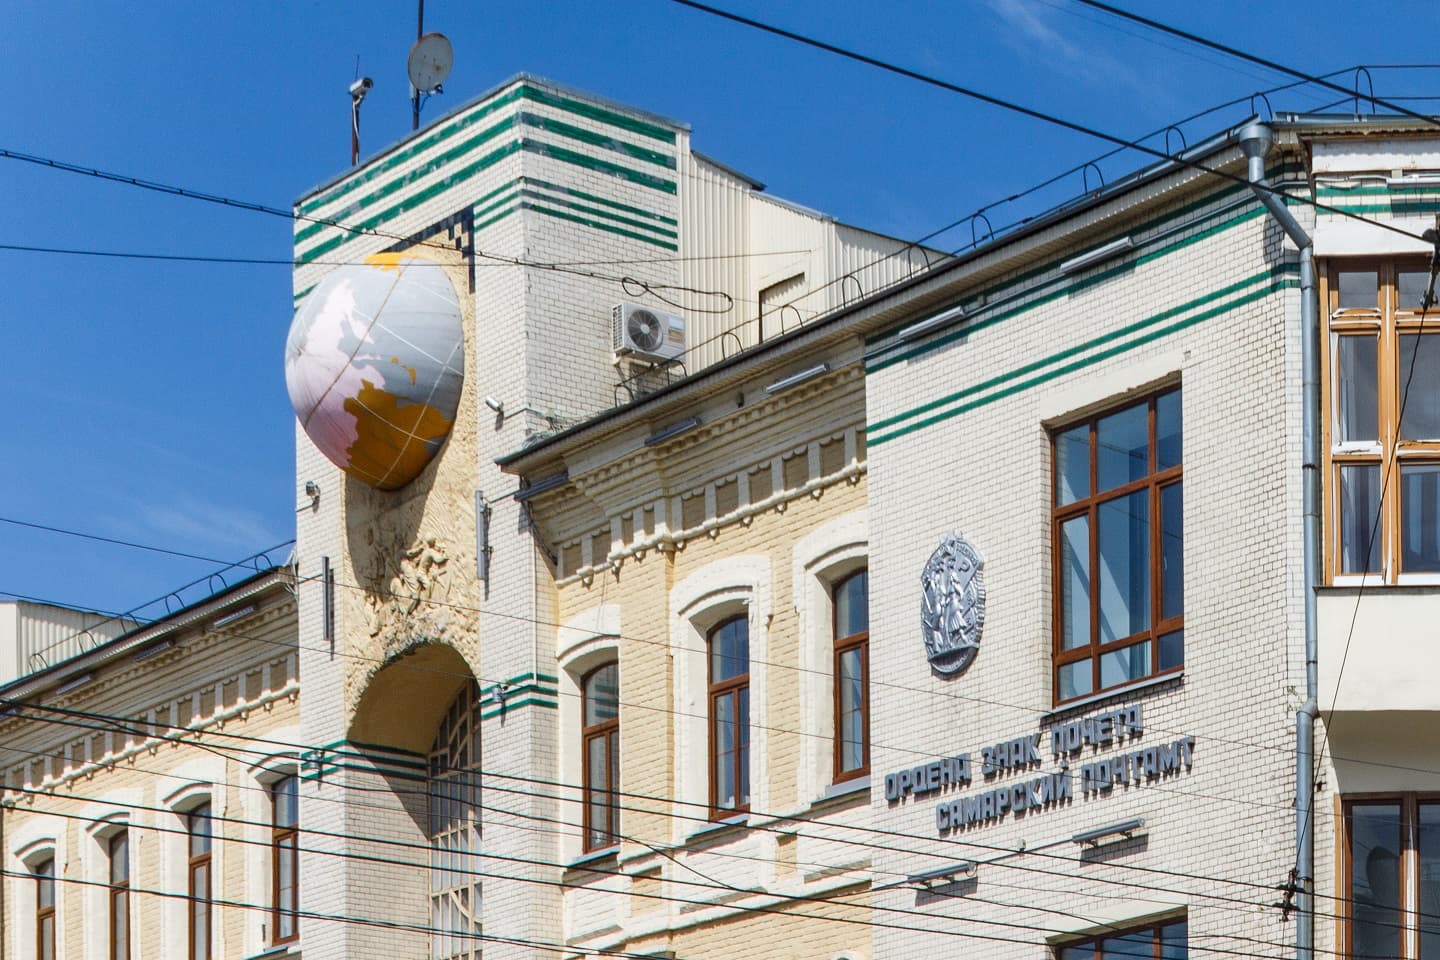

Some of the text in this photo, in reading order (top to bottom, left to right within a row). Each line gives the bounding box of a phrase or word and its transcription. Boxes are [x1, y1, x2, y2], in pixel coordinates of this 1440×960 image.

[885, 703, 1143, 801] ОРДЕНА ЗНАК ПОЧЕТА
[935, 736, 1196, 831] САМАРСКИЙ ПОЧТАМТ
